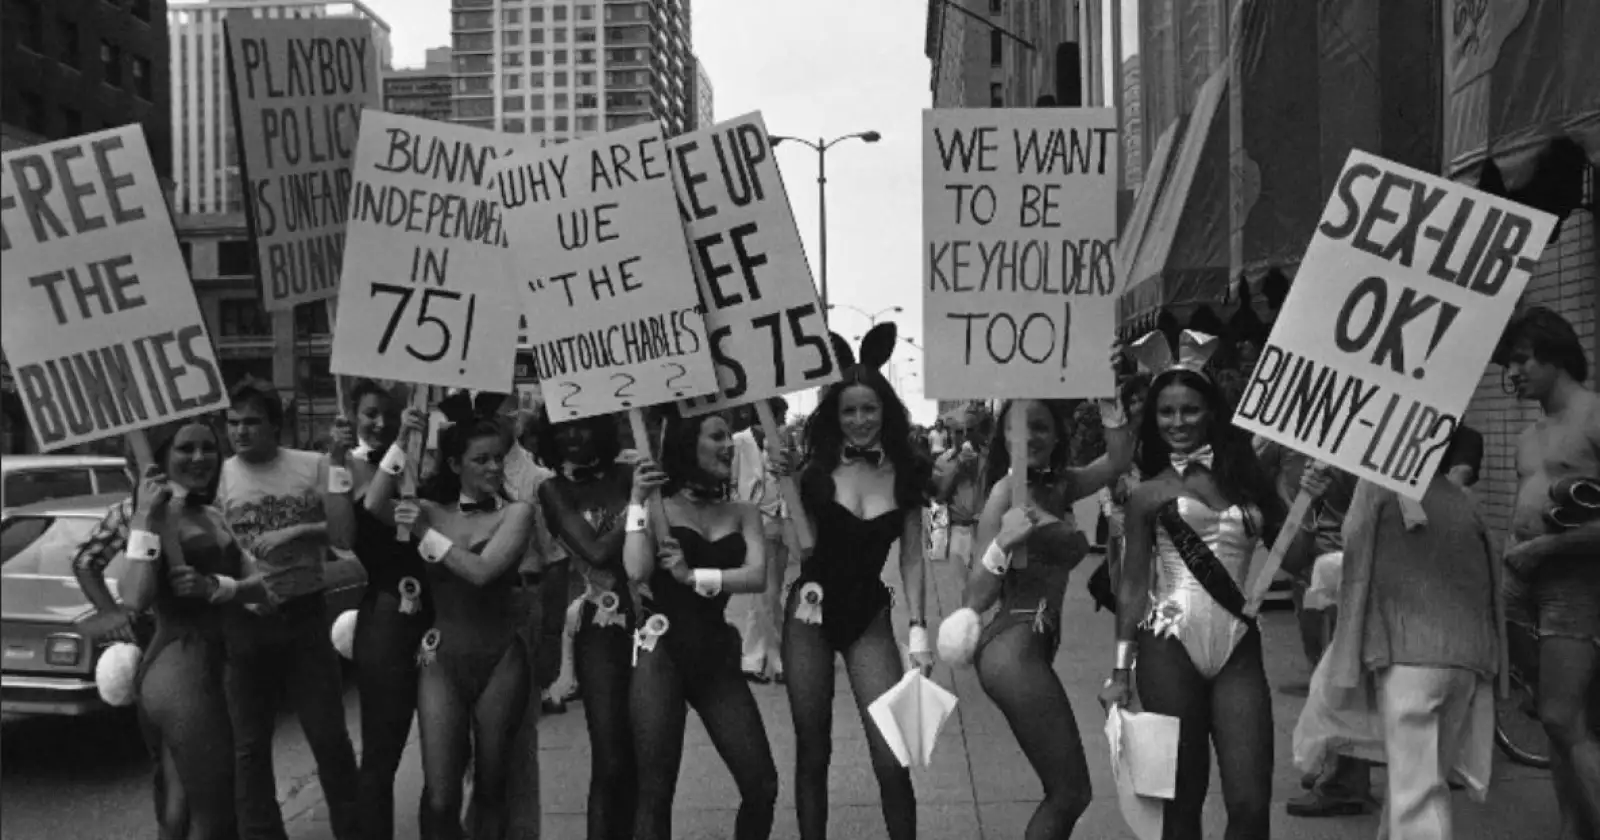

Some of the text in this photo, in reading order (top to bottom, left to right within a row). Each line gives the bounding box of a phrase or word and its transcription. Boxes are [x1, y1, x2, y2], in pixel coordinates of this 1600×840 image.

[241, 37, 366, 99] PLAYBOY
[498, 136, 665, 208] WHY ARE
[711, 123, 766, 207] UP
[934, 127, 1118, 175] WE WANT
[250, 178, 276, 237] IS
[557, 202, 620, 250] WE
[945, 184, 1062, 227] TO BE
[28, 253, 147, 325] THE
[411, 246, 449, 286] IN
[528, 256, 643, 307] "THE
[694, 221, 768, 312] EF
[930, 239, 1117, 296] KEYHOLDERS
[370, 282, 476, 375] 75!
[751, 302, 833, 388] 75
[947, 301, 1071, 383] TOO!
[1334, 276, 1461, 380] OK!
[16, 324, 222, 445] BUNNIES
[1237, 344, 1459, 487] BUNNY-LIB?
